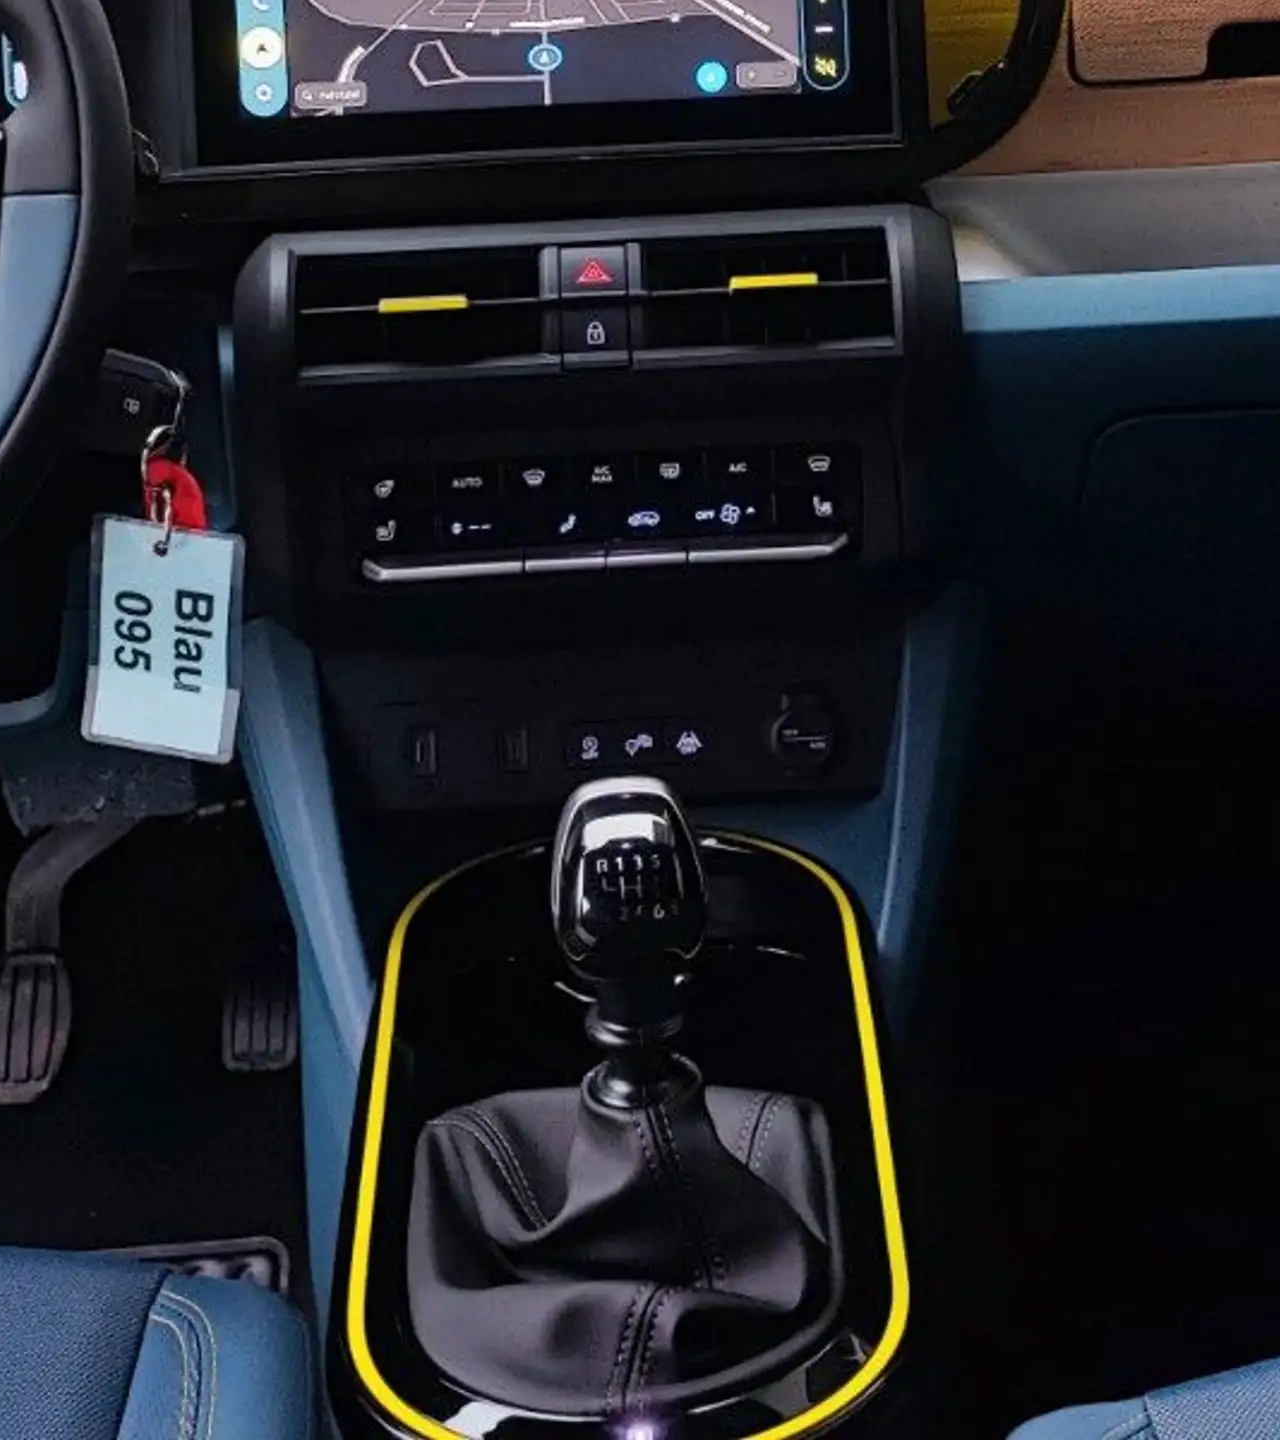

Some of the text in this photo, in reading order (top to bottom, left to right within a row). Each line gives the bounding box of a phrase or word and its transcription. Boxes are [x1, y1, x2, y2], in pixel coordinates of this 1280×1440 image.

[452, 476, 483, 489] AUTO
[114, 589, 154, 673] 095
[174, 588, 215, 694] Blau
